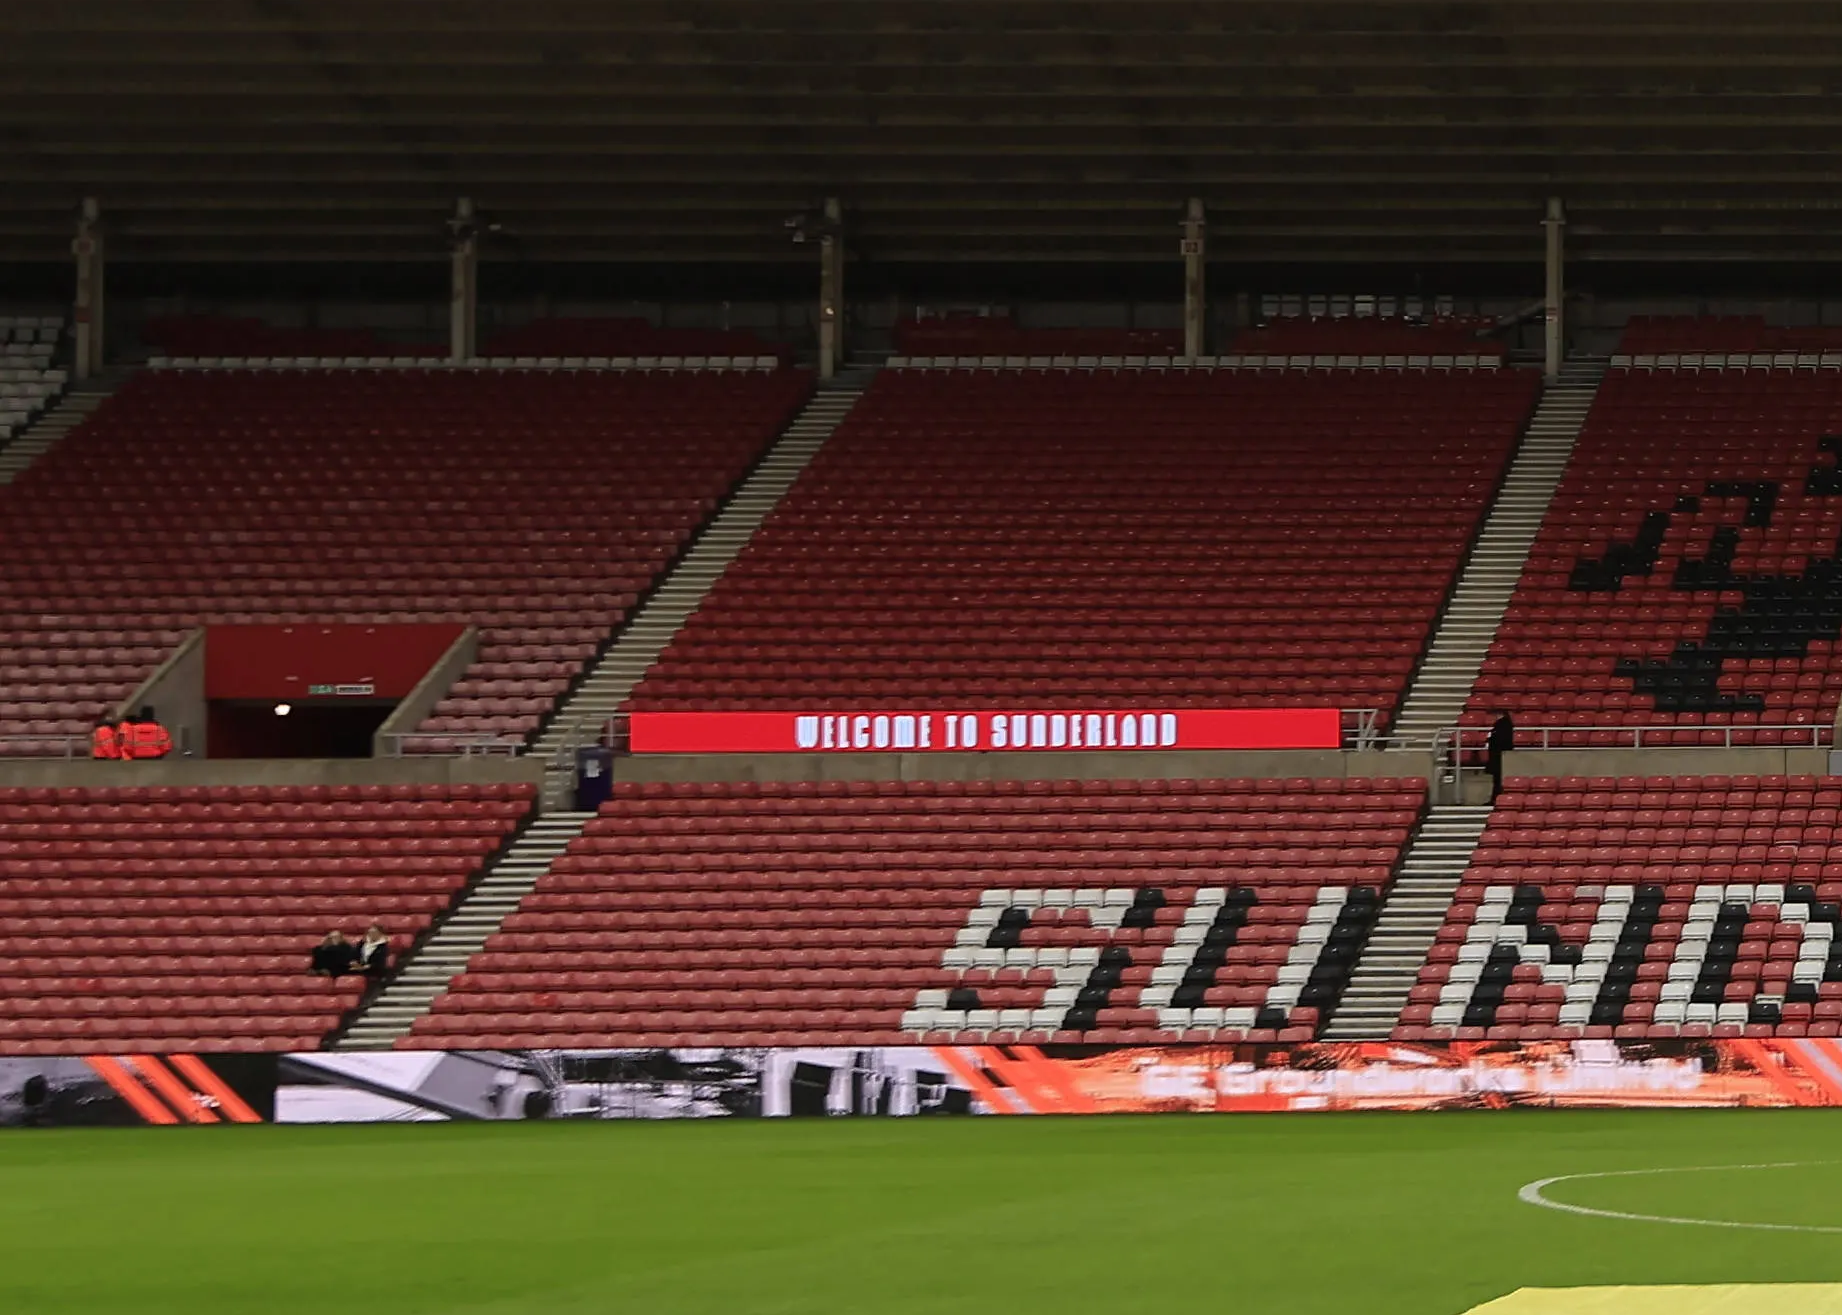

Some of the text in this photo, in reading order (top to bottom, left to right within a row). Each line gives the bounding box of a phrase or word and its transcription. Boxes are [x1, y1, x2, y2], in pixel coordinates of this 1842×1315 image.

[795, 713, 1177, 749] WELCOME TO SUNDERLAND
